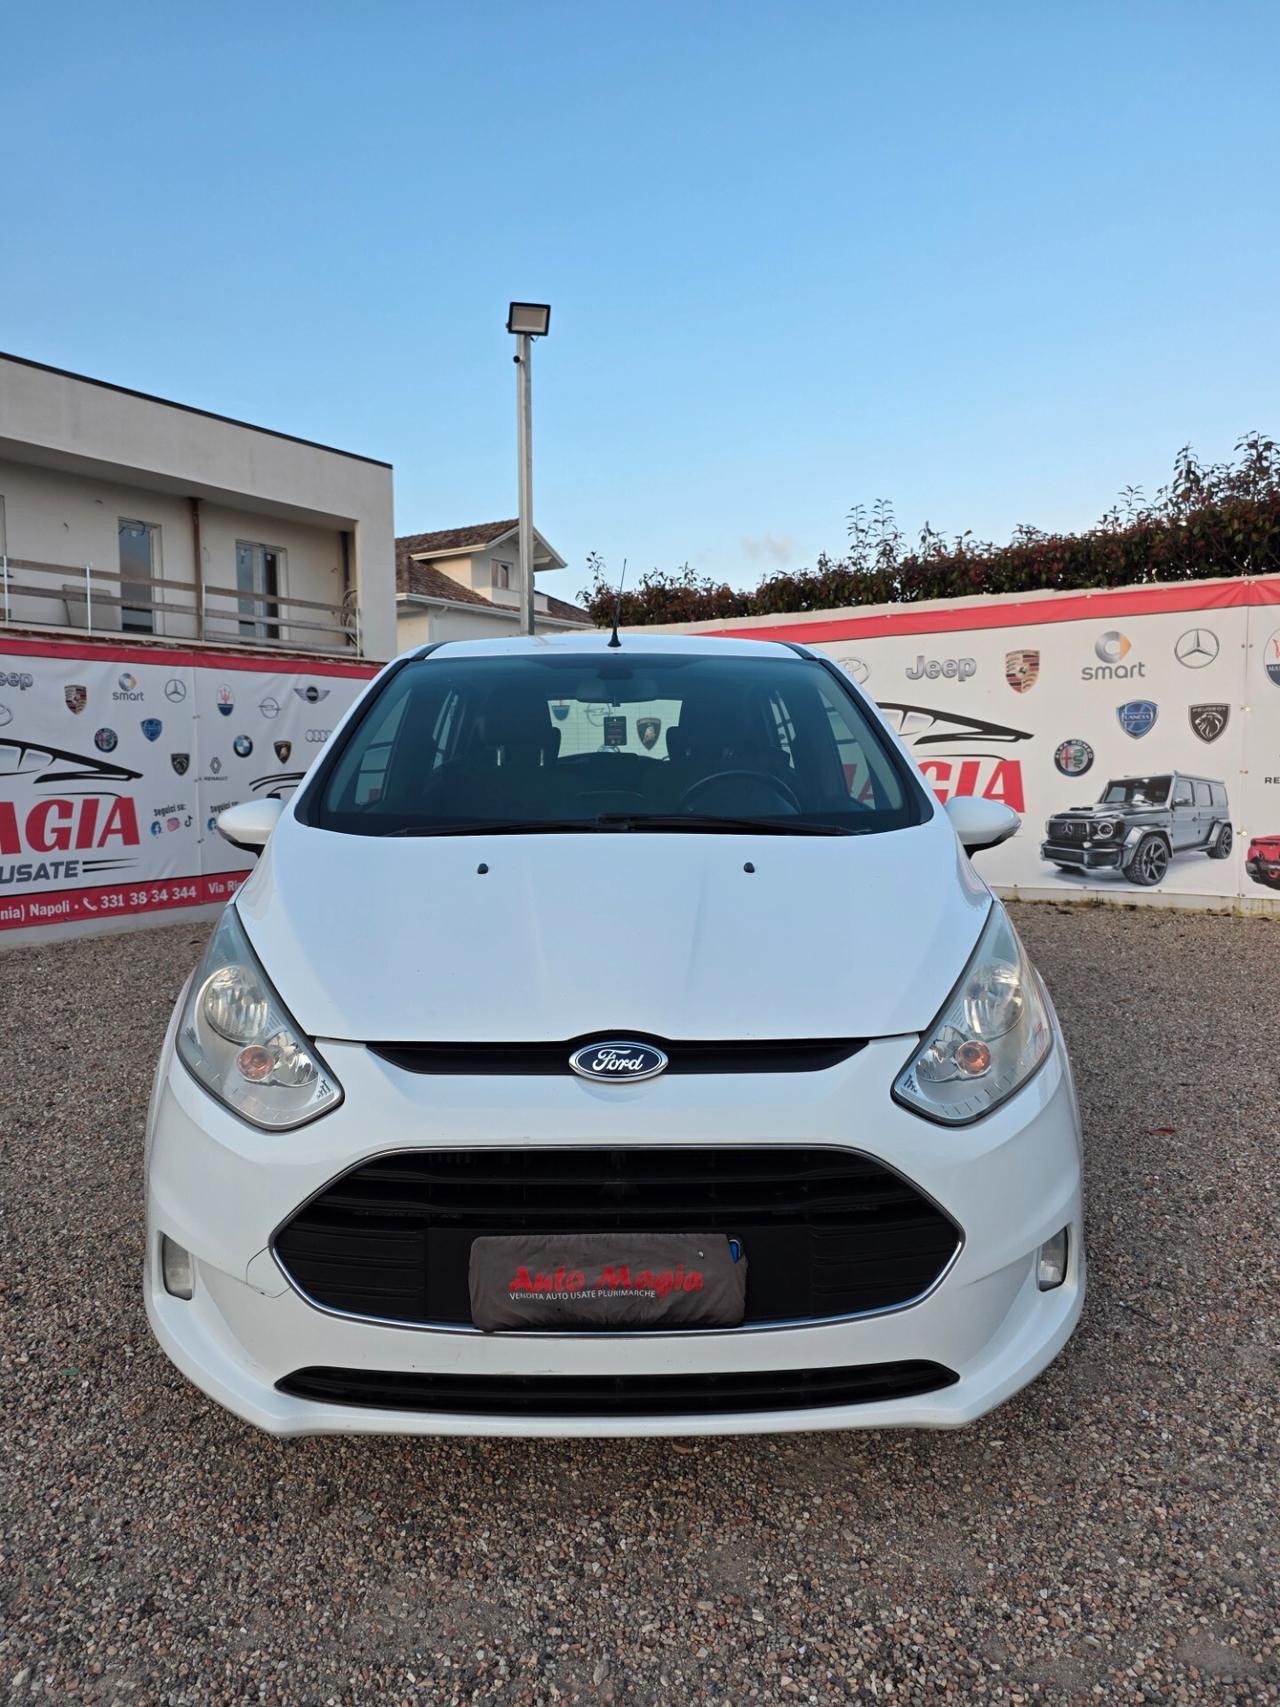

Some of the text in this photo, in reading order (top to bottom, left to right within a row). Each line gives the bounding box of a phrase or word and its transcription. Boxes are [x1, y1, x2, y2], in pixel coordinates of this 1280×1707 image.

[905, 656, 977, 682] Jeep
[1081, 661, 1146, 681] smart
[112, 691, 144, 701] smart
[0, 860, 79, 884] USATE
[208, 879, 242, 895] Via Ri
[29, 900, 70, 917] Napoli
[100, 893, 125, 909] 331
[129, 891, 148, 905] 38
[151, 888, 169, 903] 34
[172, 885, 198, 900] 344
[592, 1048, 644, 1072] Ford
[508, 1264, 704, 1297] Auto Magia
[509, 1289, 656, 1301] VENDITA AUTO USATE PLURIMARCHE
